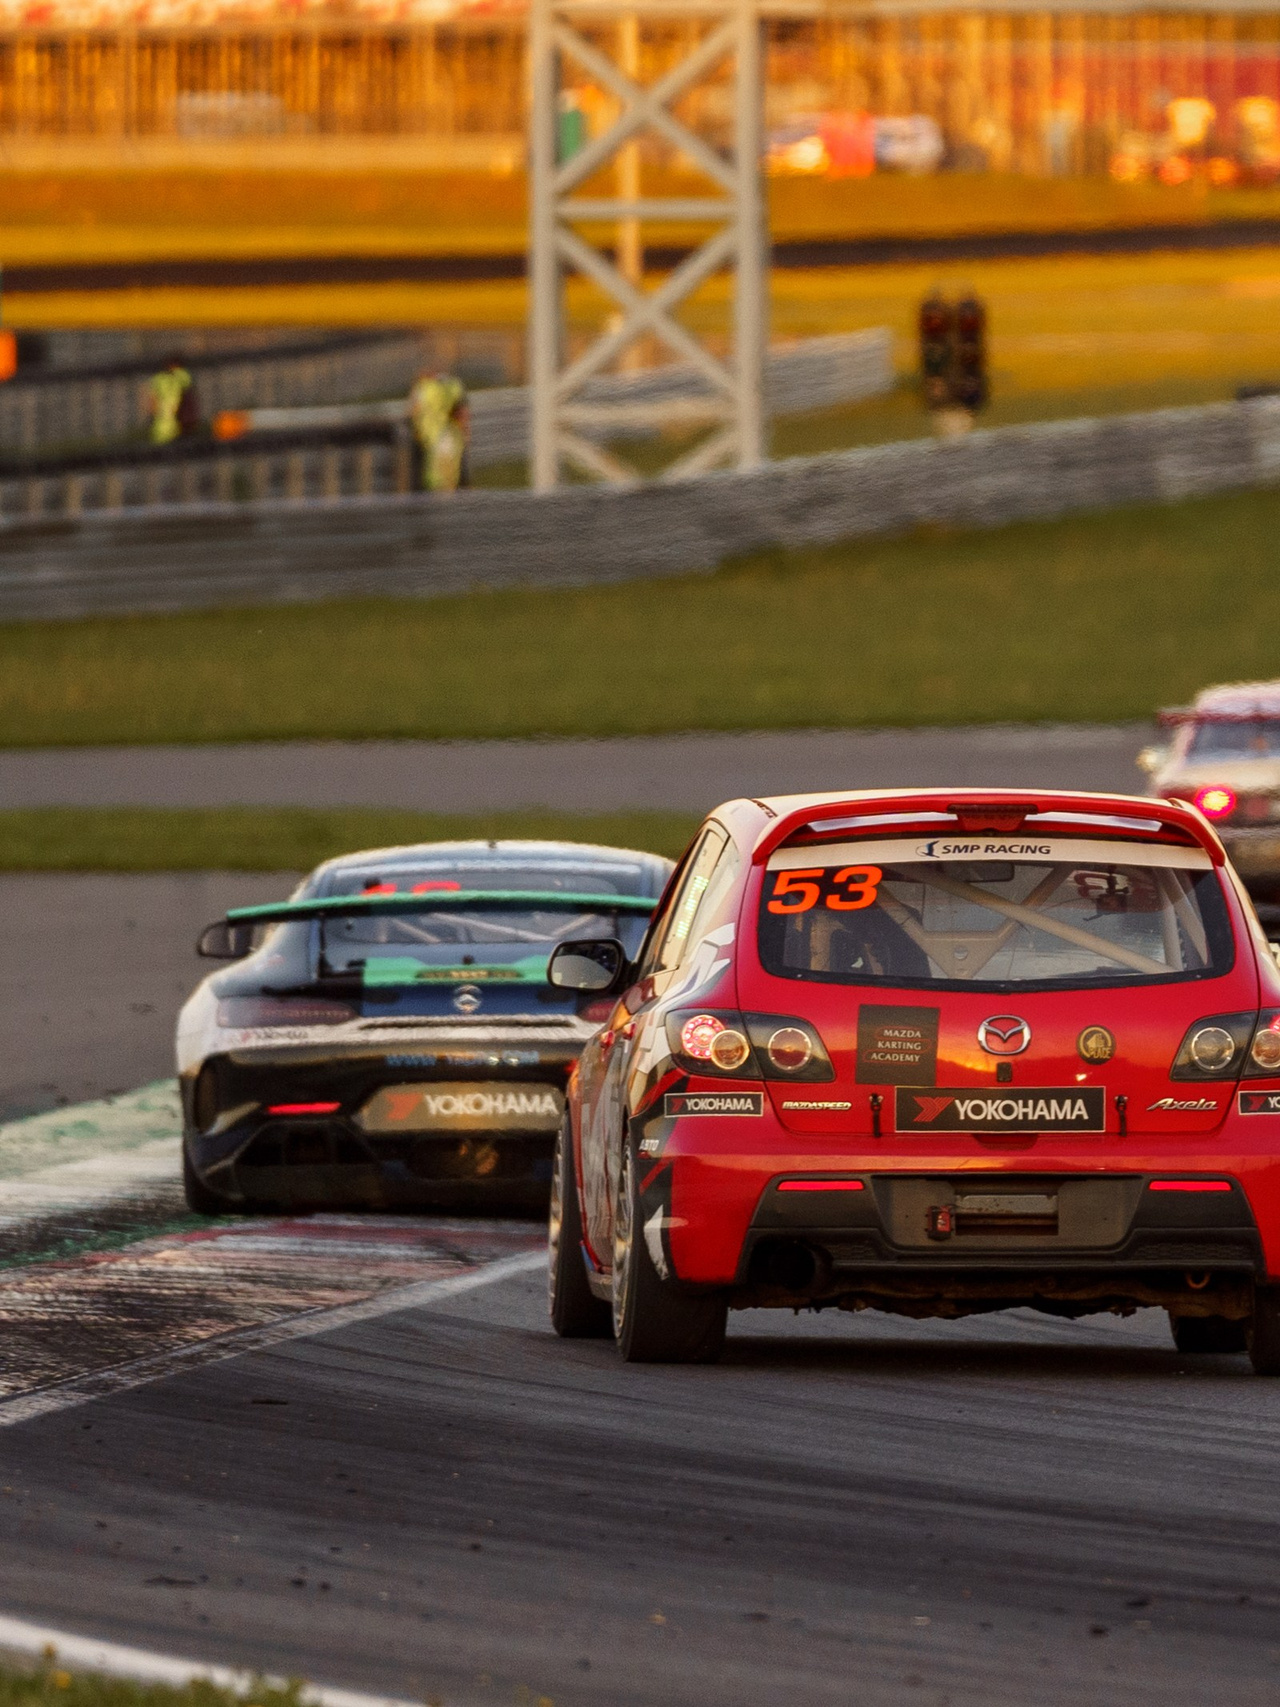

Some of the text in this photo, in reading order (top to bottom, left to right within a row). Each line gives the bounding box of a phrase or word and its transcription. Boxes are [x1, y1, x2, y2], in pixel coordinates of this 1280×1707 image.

[941, 844, 1051, 855] SMP RACING
[767, 865, 883, 915] 53
[883, 1029, 922, 1038] MAZDA
[877, 1040, 922, 1051] KARTING
[870, 1052, 920, 1062] ACADEMY
[424, 1091, 560, 1116] YOKOHAMA
[685, 1098, 755, 1111] YOKOHAMA
[954, 1099, 1090, 1121] YOKOHAMA
[1146, 1097, 1220, 1111] Axela
